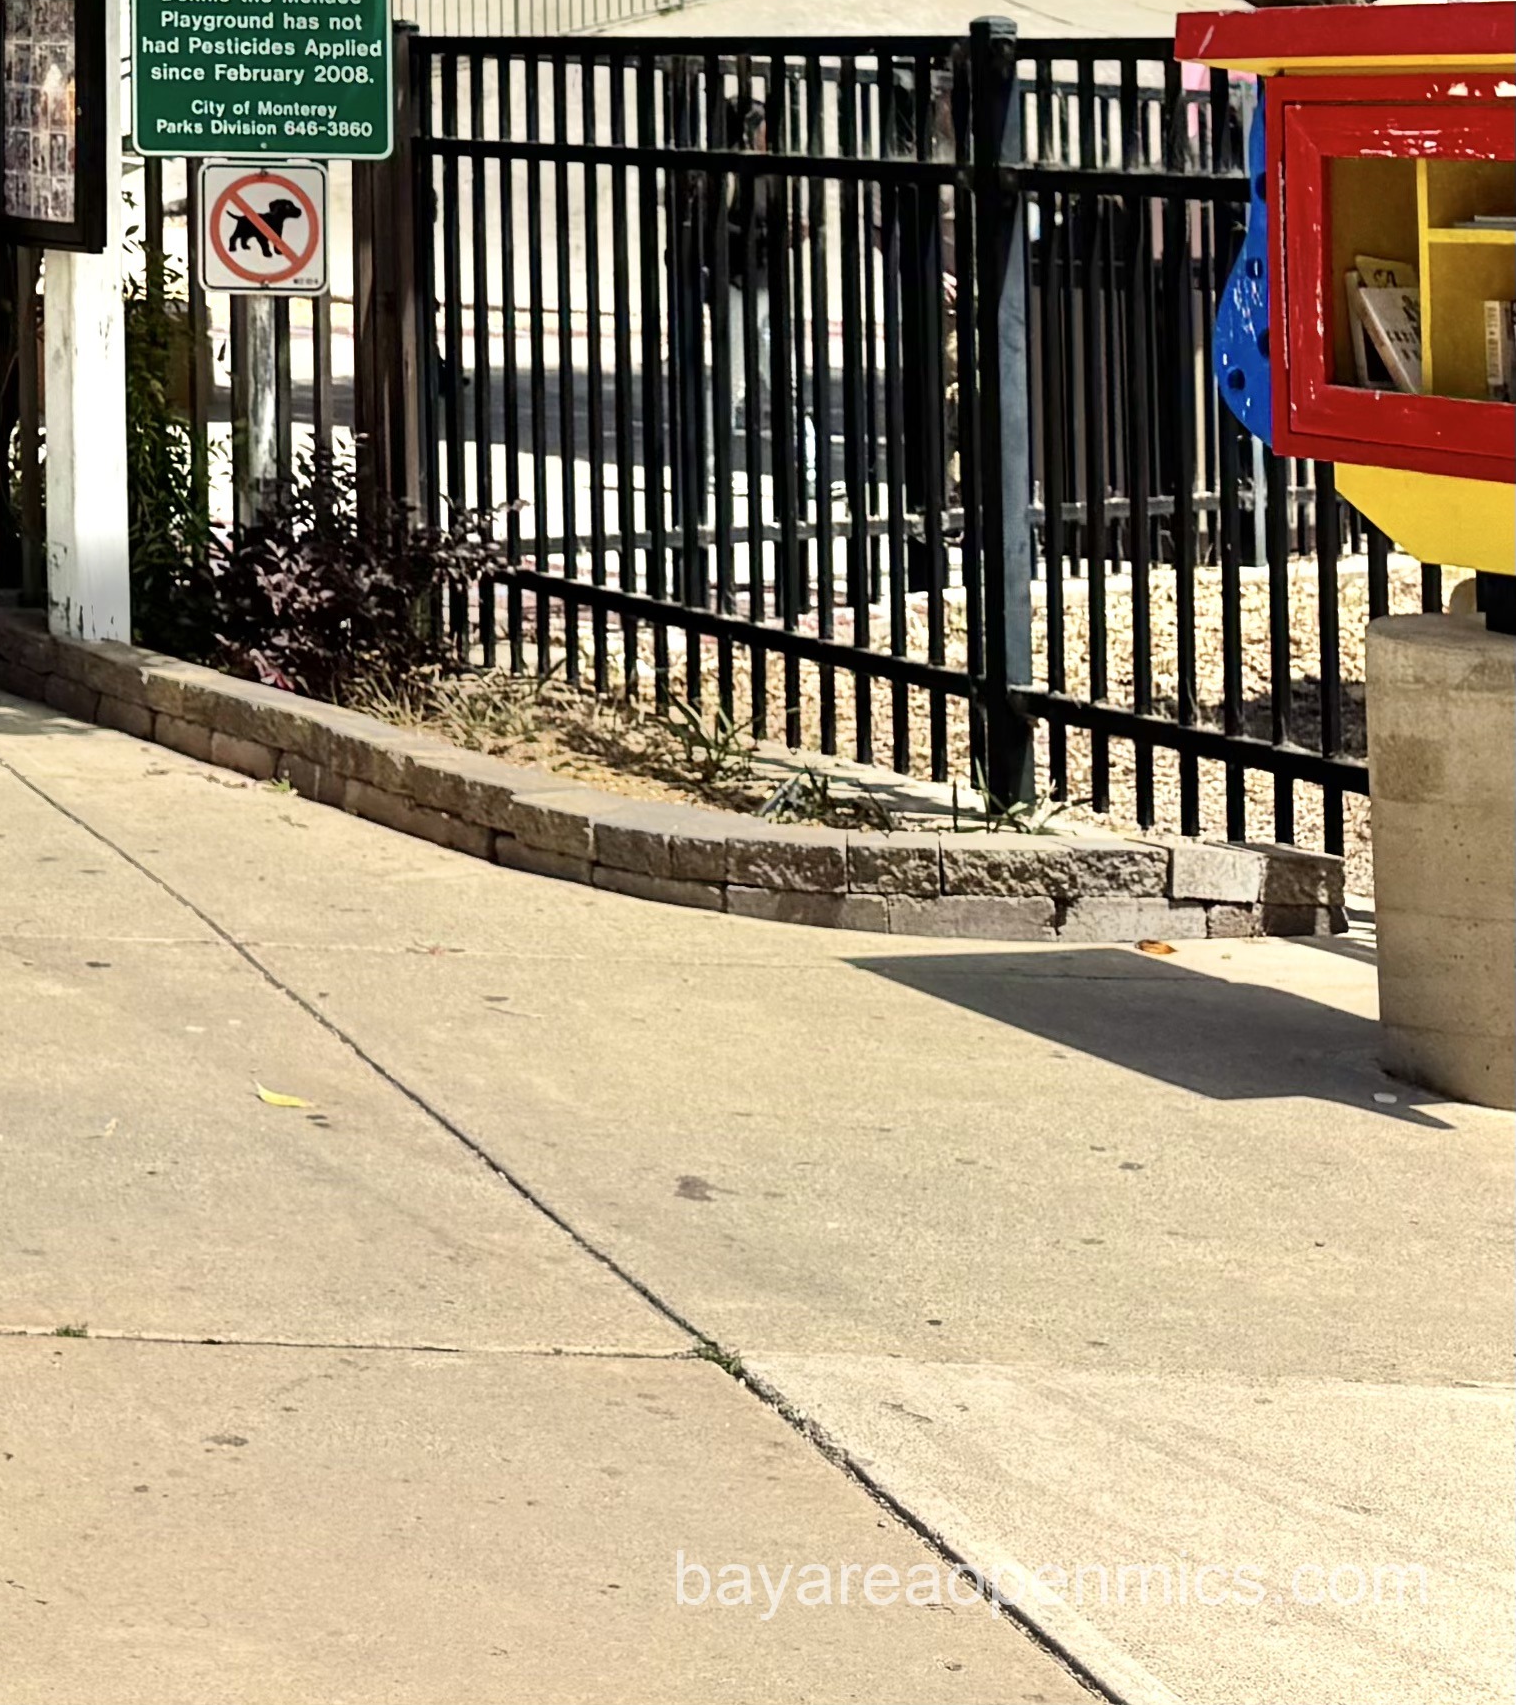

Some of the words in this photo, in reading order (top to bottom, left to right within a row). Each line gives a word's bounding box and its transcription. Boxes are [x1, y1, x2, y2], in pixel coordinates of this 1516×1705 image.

[161, 10, 274, 32] Playground
[283, 12, 320, 30] has
[329, 14, 363, 31] not
[142, 36, 180, 54] had
[188, 36, 296, 56] Pesticides
[305, 38, 382, 60] Applied
[150, 62, 205, 81] since
[214, 63, 305, 86] February
[314, 65, 374, 84] 2008.
[191, 99, 226, 118] City
[232, 100, 250, 115] of
[257, 101, 337, 118] Monterey
[156, 118, 204, 135] Parks
[211, 119, 277, 136] Division
[284, 121, 373, 137] 646-3860
